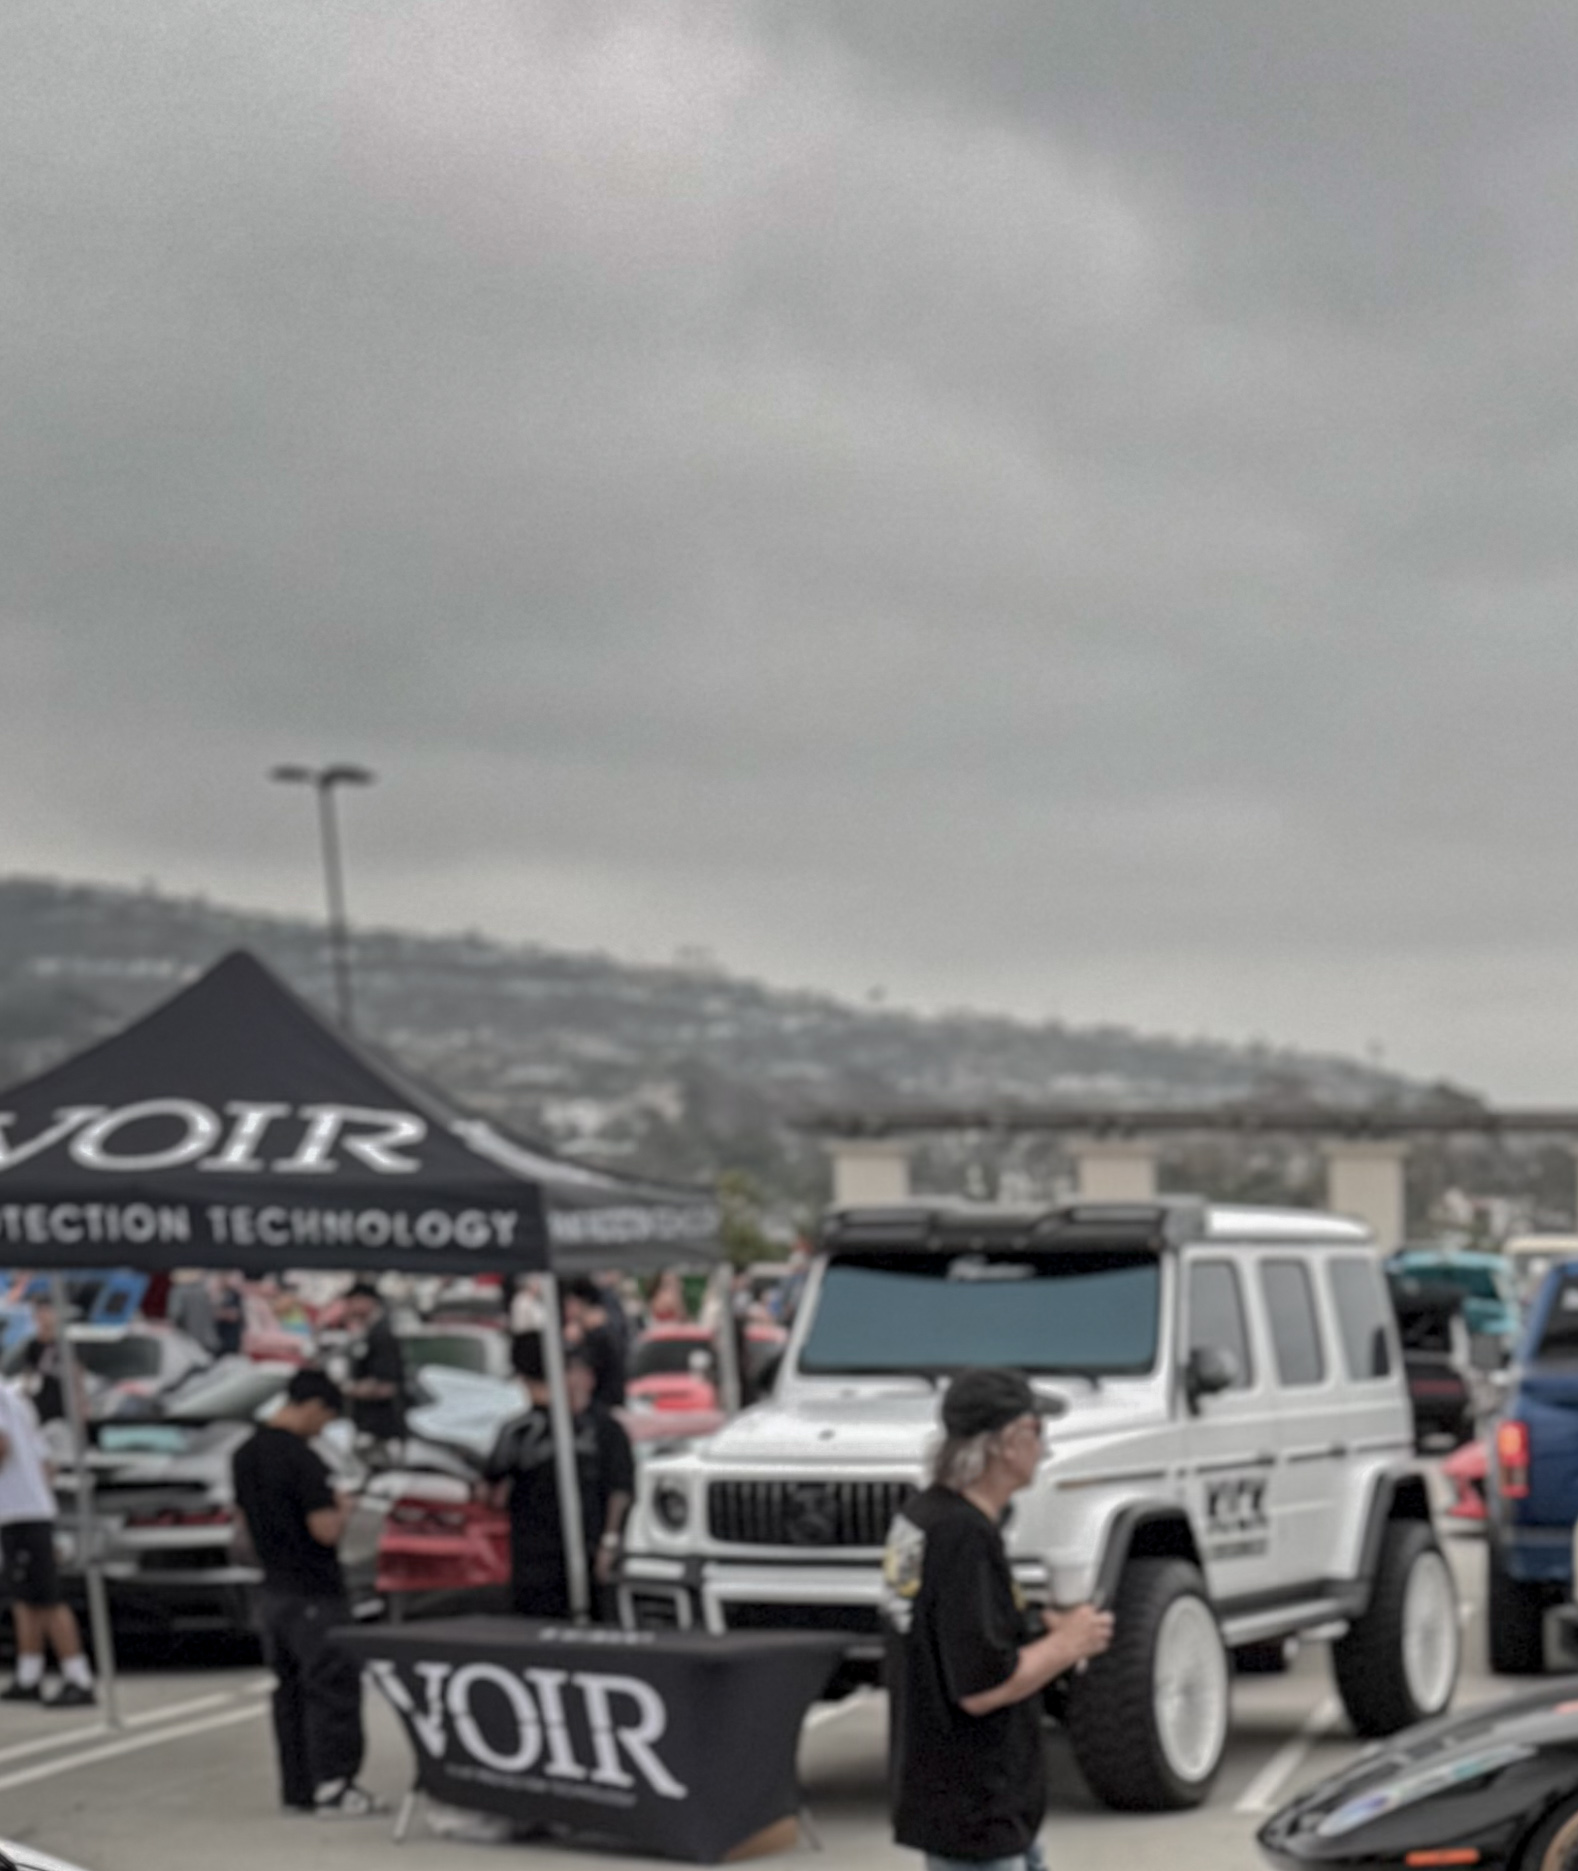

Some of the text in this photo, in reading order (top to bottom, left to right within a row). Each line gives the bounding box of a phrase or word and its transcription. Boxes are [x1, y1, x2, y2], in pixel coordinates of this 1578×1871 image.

[0, 1098, 427, 1172] VOIR
[0, 1202, 190, 1243] TECTION
[205, 1204, 518, 1248] TECHNOLOGY
[364, 1660, 688, 1799] VOIR
